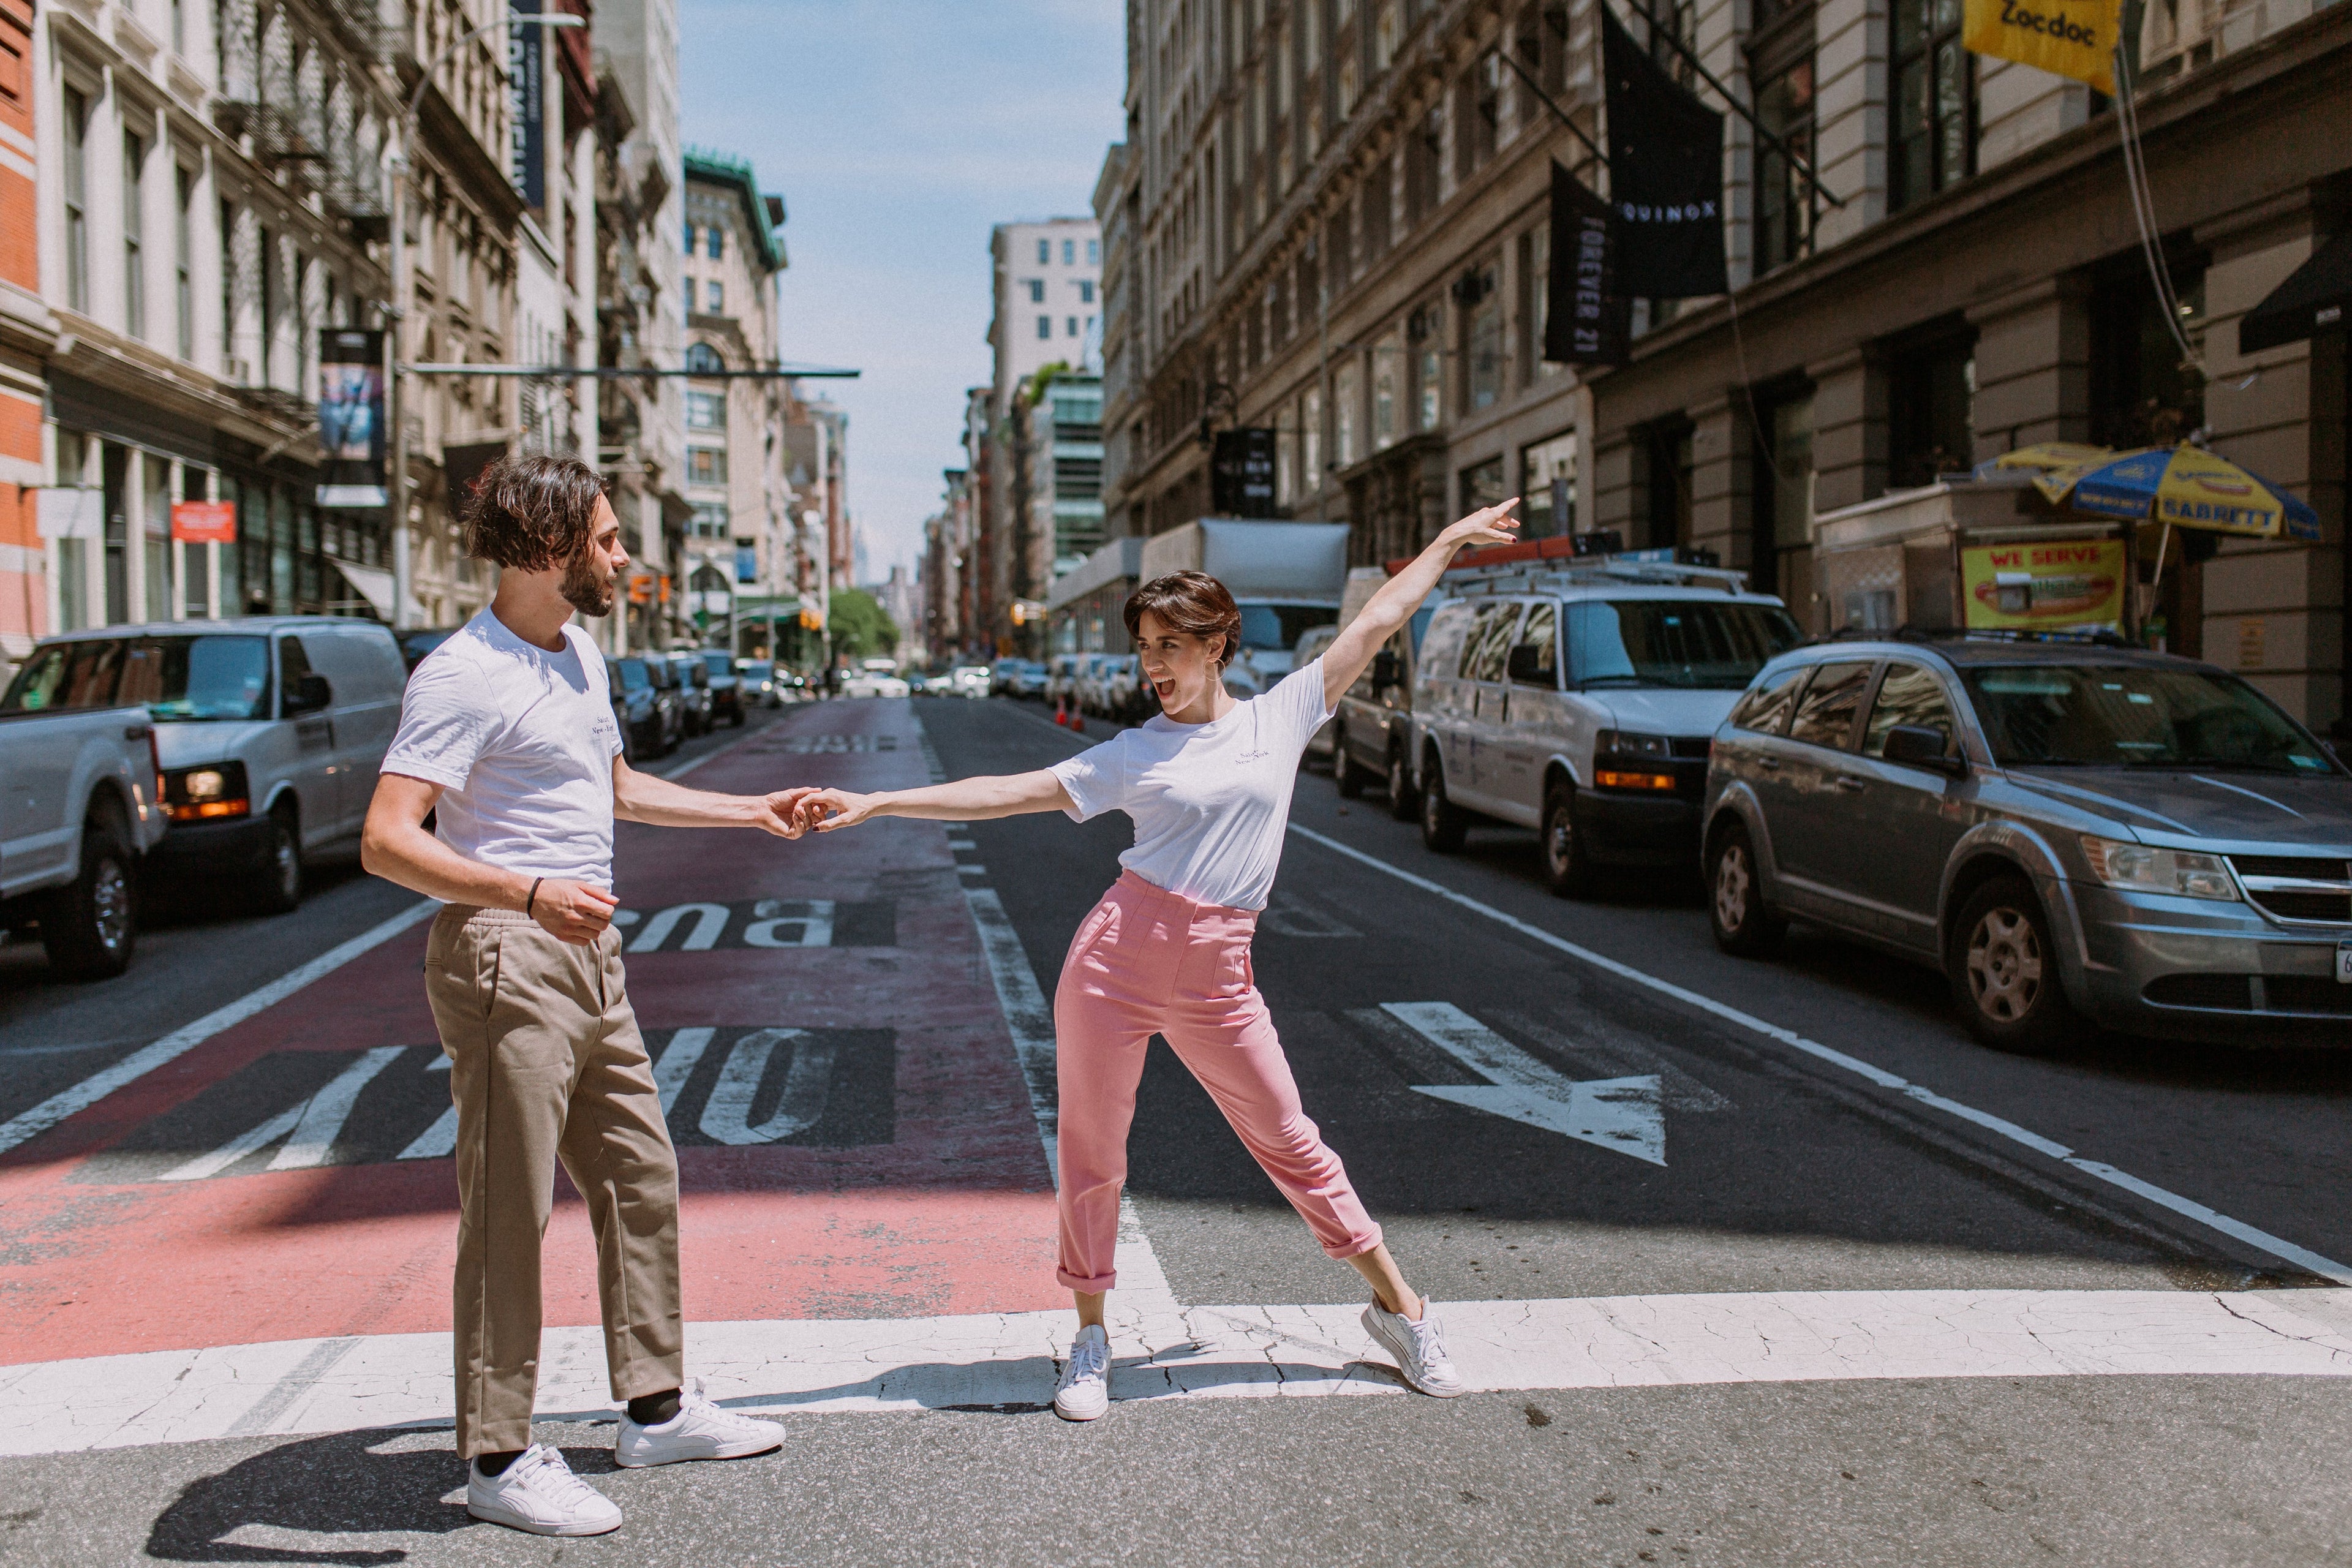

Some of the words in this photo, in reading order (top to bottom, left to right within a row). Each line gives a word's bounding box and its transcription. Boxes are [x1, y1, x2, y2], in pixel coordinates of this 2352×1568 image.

[2000, 0, 2095, 46] Zocdoc
[1615, 200, 1716, 223] QUINOX
[1574, 328, 1599, 353] 21
[2163, 498, 2275, 527] SABRETT
[1990, 550, 2023, 567] WE
[2031, 548, 2100, 565] SERVE
[612, 899, 835, 952] BU
